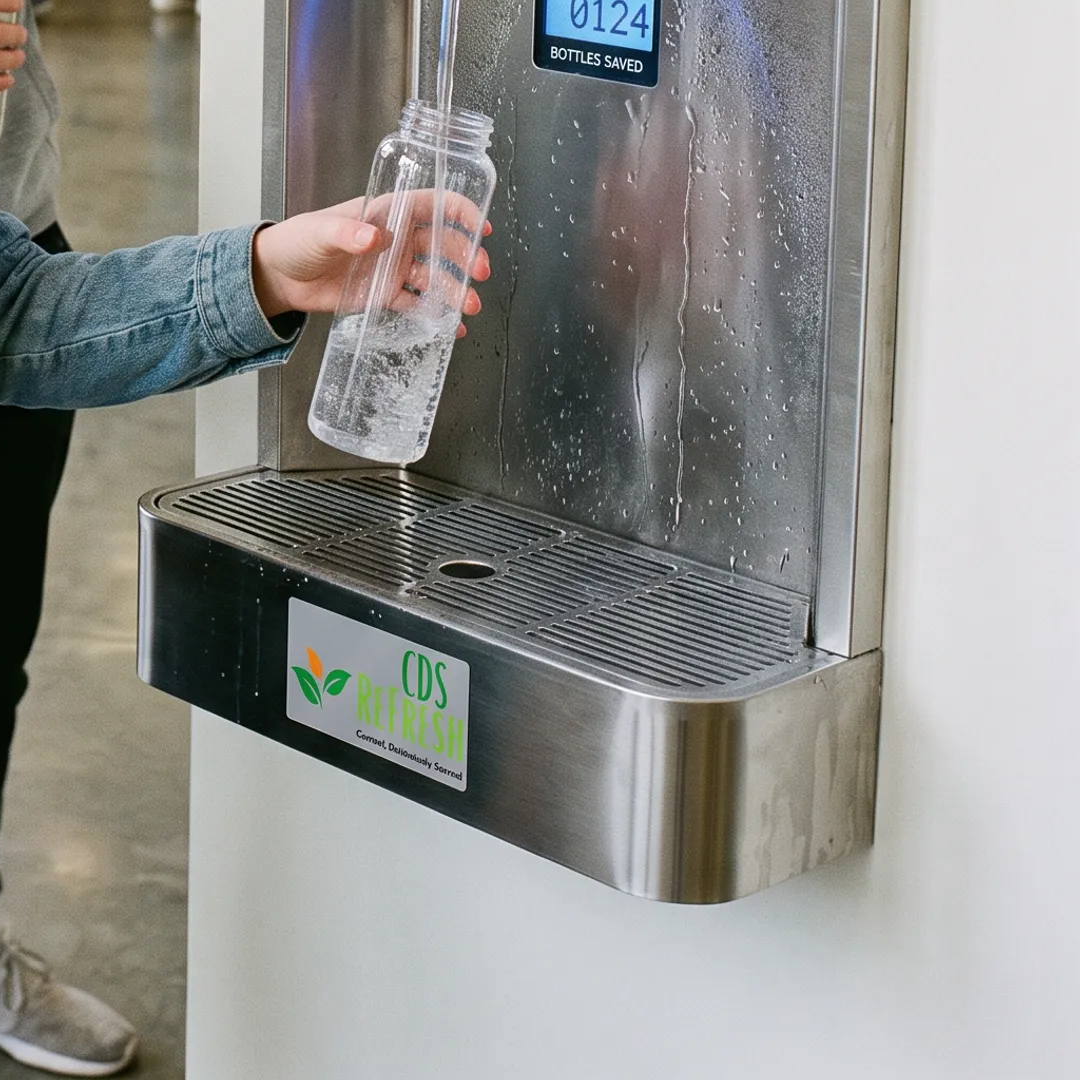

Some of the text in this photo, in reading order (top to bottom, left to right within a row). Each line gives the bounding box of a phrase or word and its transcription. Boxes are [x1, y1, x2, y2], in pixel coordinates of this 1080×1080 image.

[550, 46, 643, 73] BOTTLES SAVED
[402, 650, 448, 710] CDS
